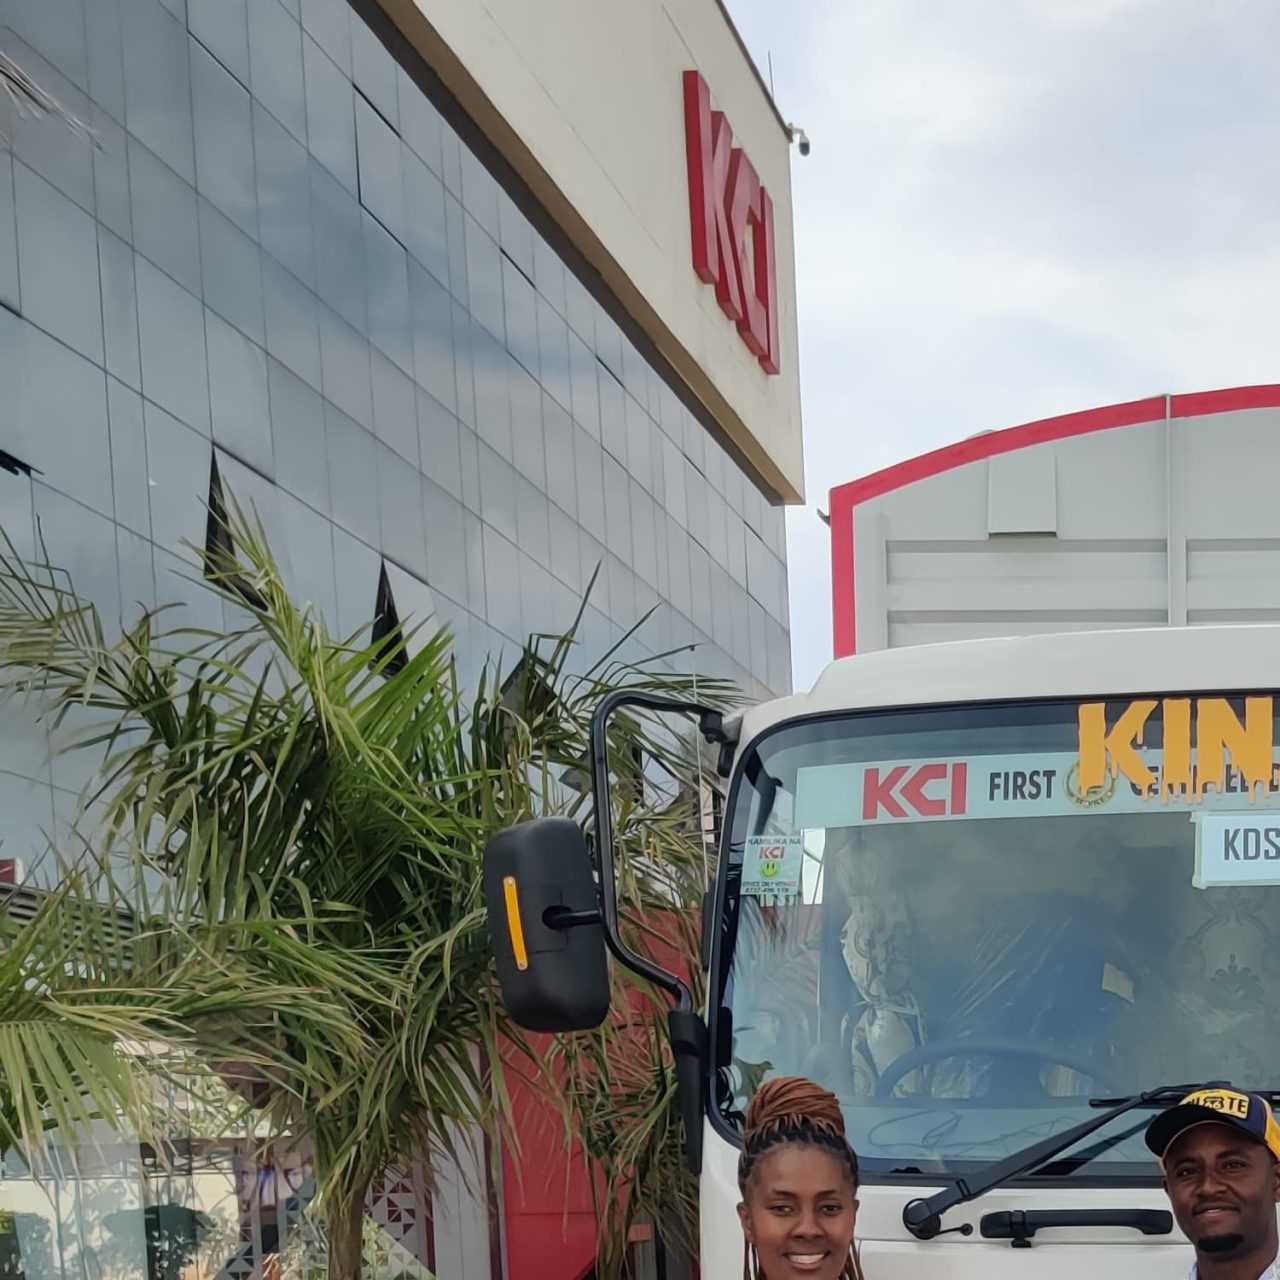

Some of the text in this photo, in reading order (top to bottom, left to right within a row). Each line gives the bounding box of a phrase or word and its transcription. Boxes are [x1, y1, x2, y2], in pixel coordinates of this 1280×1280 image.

[682, 69, 780, 375] KCI
[862, 762, 967, 820] KCI
[988, 769, 1057, 801] FIRST
[759, 846, 785, 859] KCI
[1223, 828, 1280, 861] KDS
